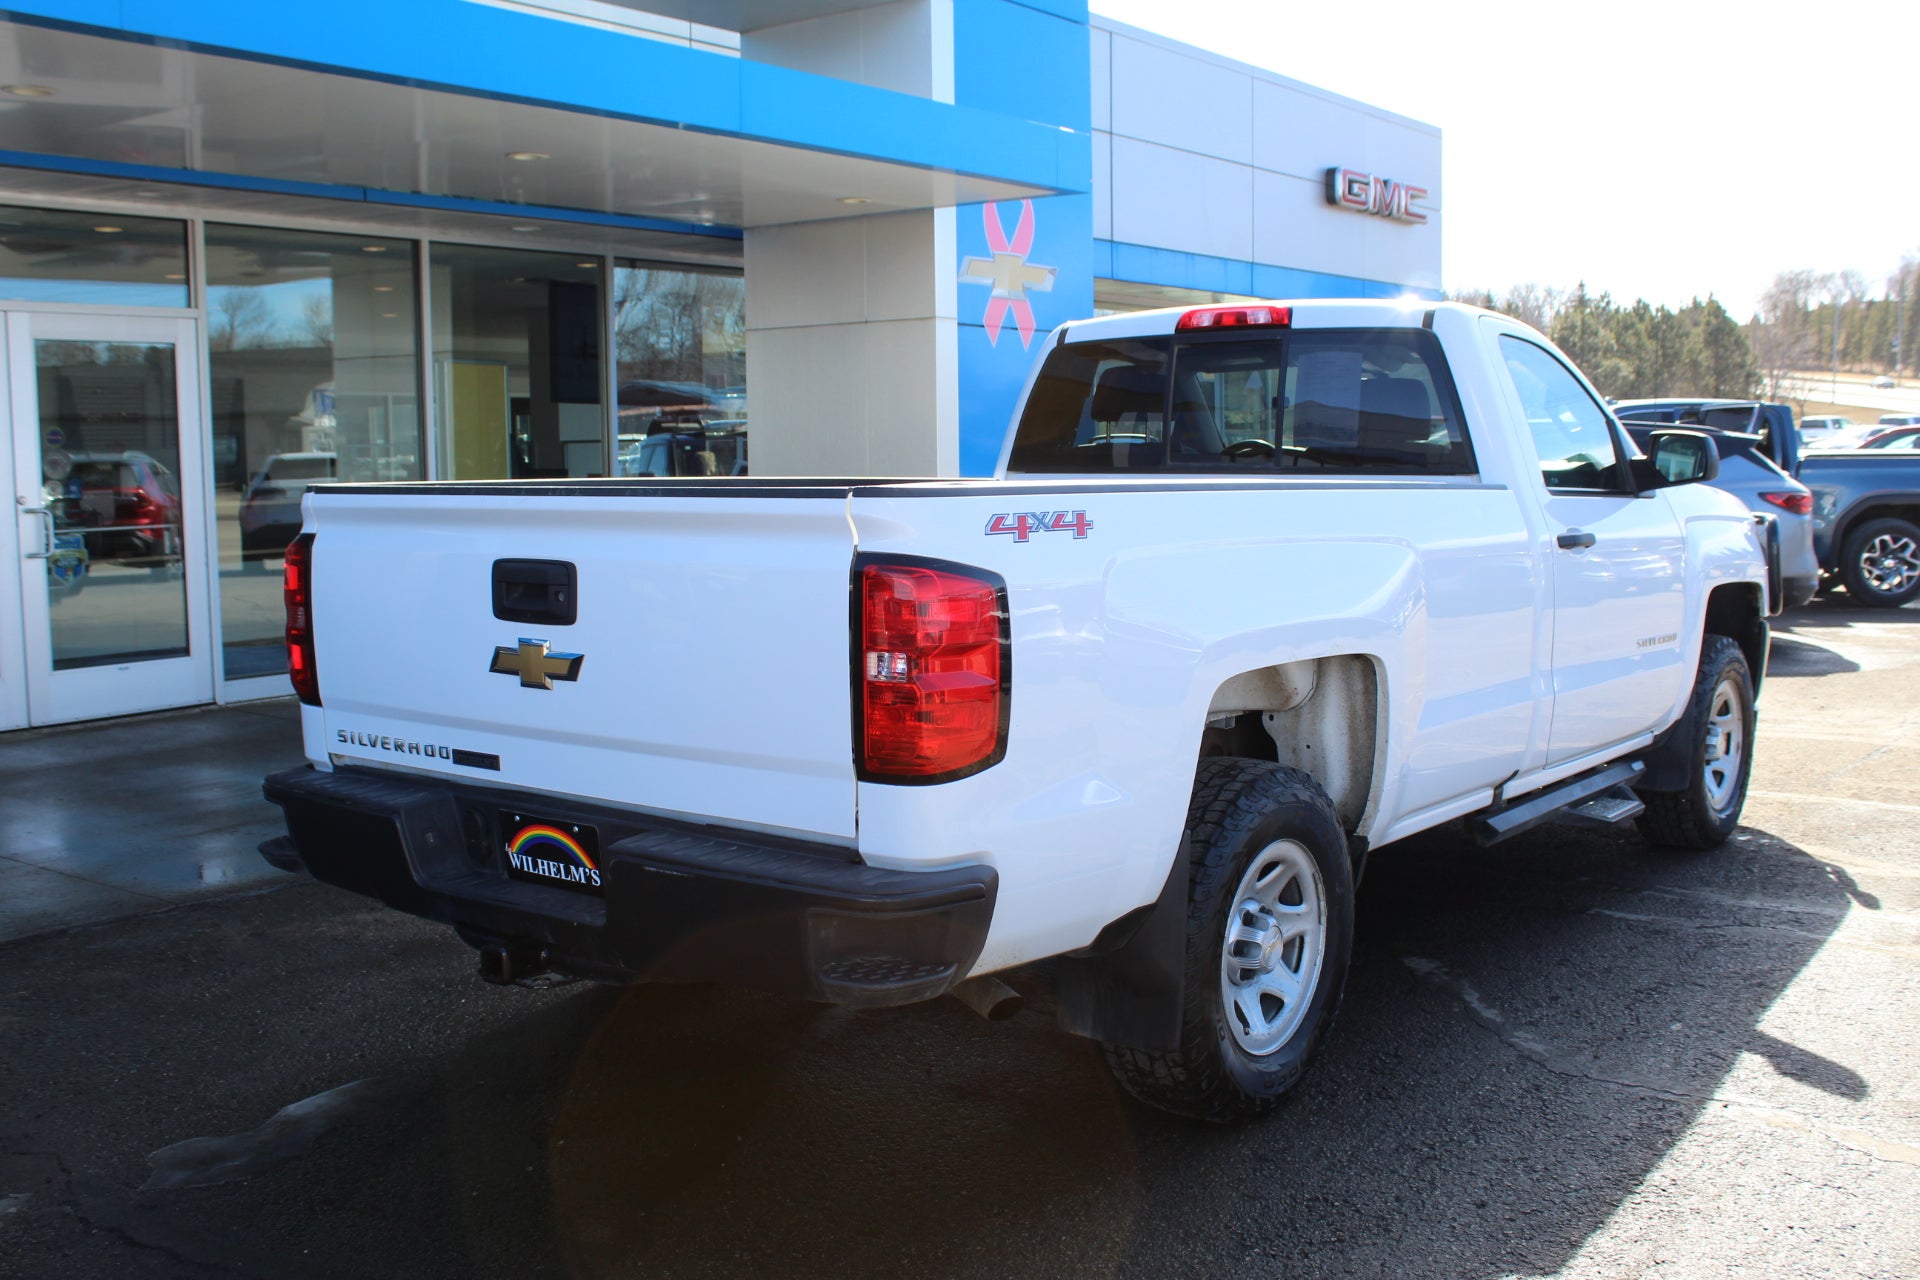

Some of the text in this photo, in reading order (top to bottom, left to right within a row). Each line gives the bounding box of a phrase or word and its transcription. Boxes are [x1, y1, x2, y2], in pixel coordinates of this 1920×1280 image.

[1338, 168, 1427, 222] GMC
[337, 728, 451, 760] SILVERADO
[506, 848, 601, 887] WILHELM'S
